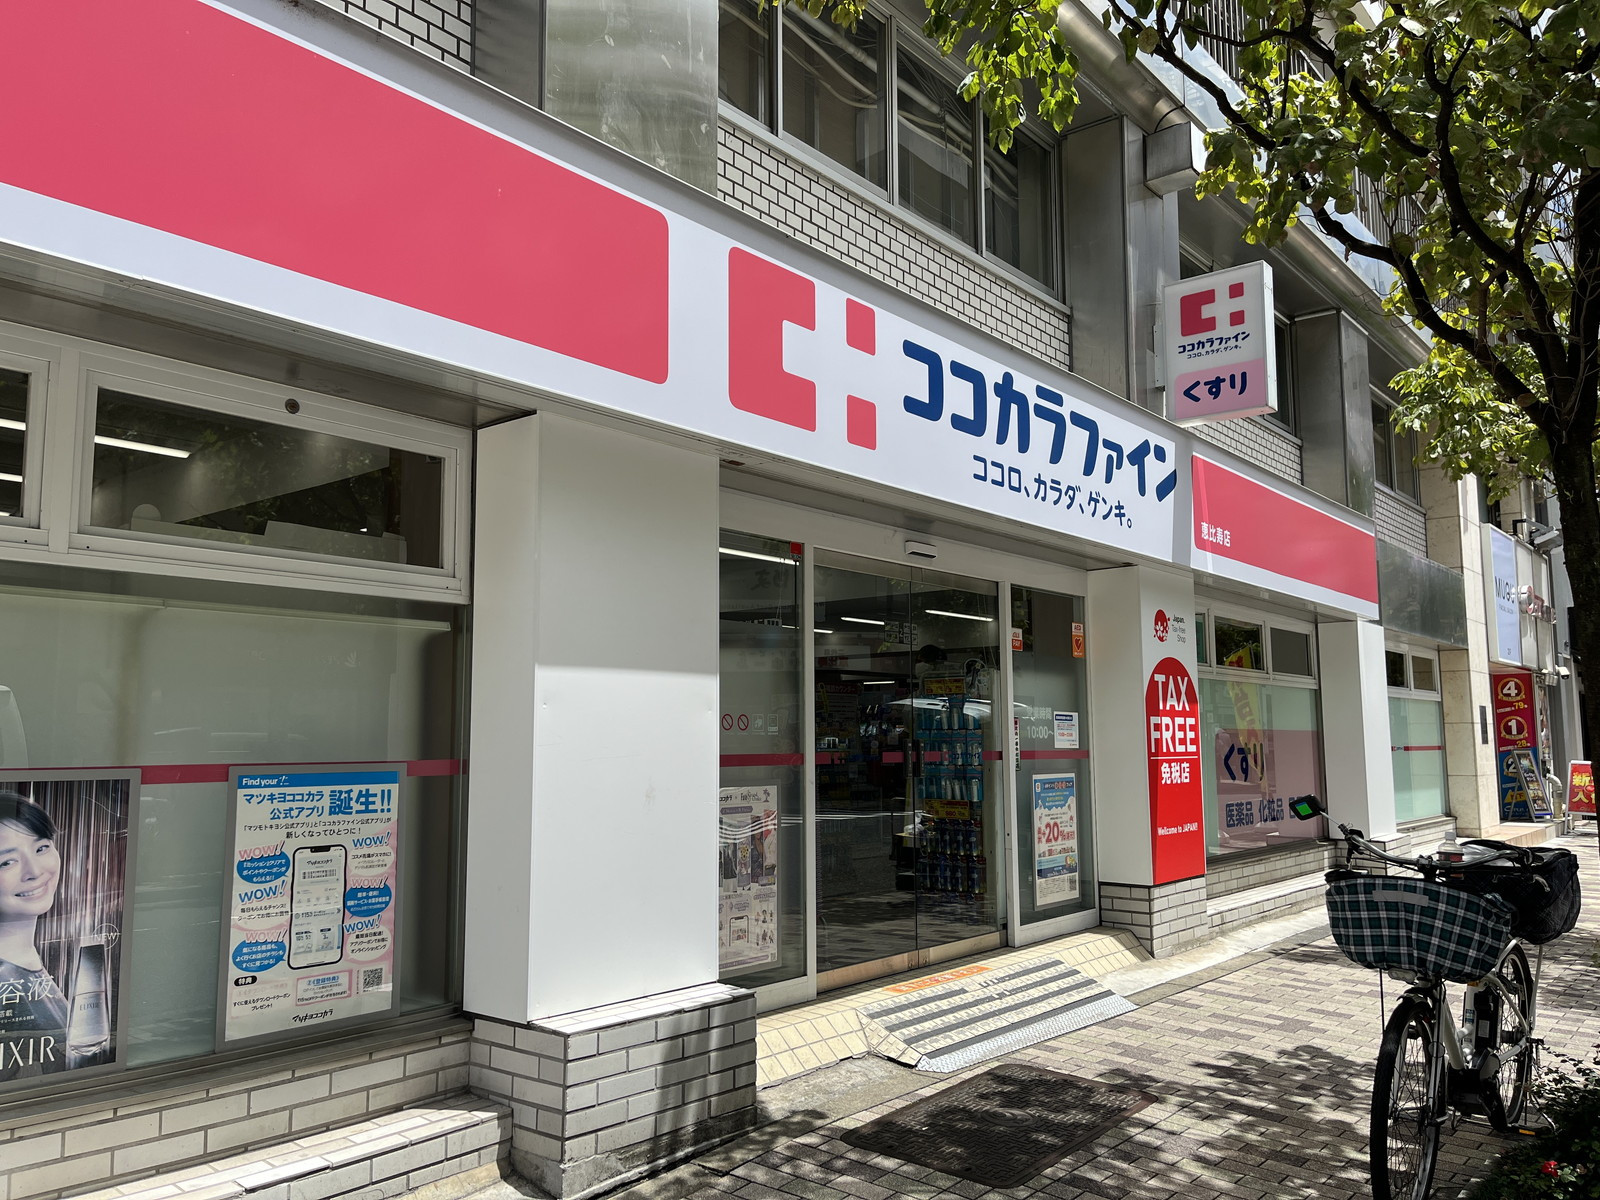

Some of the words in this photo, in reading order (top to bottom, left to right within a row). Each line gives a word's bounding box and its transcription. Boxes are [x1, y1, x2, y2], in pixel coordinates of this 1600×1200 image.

[1178, 331, 1250, 354] ココカラファイン
[1187, 345, 1242, 359] ココロ、カラダ、ゲンキ。
[1183, 371, 1248, 402] くすり
[902, 339, 1177, 502] ココカラファイン
[972, 454, 1132, 528] ココロ、カラダ、ゲンキ。
[1177, 634, 1186, 644] Shop
[1154, 673, 1190, 711] TAX
[1502, 681, 1518, 697] 4
[1150, 716, 1197, 753] FREE
[1508, 719, 1517, 735] 1
[1161, 762, 1190, 785] 免税店
[1223, 742, 1264, 782] くすり
[242, 778, 260, 786] Find
[261, 778, 278, 787] your
[243, 790, 324, 804] マツキヨココカラ
[328, 788, 392, 816] 誕生!!
[243, 817, 391, 831] 「マツモトキヨシ公式アプリ」と「ココカラファイン公式アプリ」が
[270, 805, 324, 820] 公式アプリ
[1226, 802, 1254, 828] 医薬品
[1258, 797, 1284, 824] 化粧品
[352, 831, 391, 849] WOW!
[238, 879, 287, 904] WOW!
[343, 913, 382, 933] WOW!
